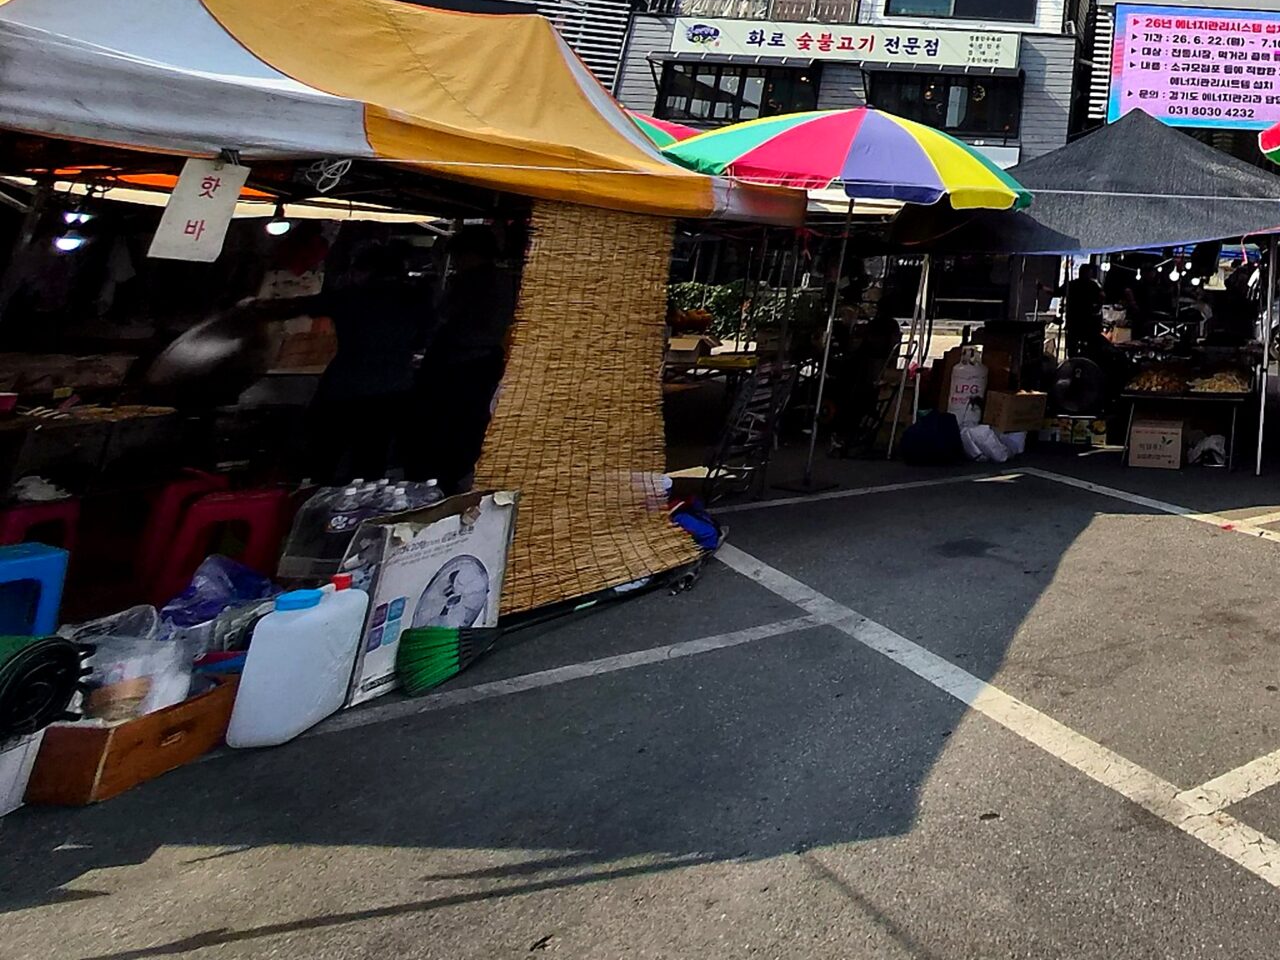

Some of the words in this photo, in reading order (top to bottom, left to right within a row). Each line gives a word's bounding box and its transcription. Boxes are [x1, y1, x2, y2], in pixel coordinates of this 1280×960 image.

[1145, 18, 1172, 29] 26년
[1175, 20, 1262, 34] 에너지관리시스템
[745, 29, 786, 49] 화로
[796, 31, 876, 54] 숯불고기
[884, 36, 939, 57] 전문점
[1143, 33, 1162, 43] 기간
[1142, 47, 1161, 57] 대상
[1218, 51, 1247, 61] 먹거리
[1141, 61, 1160, 71] 내용
[1171, 63, 1220, 74] 소규모점포
[1246, 66, 1276, 76] 적합한
[1253, 81, 1273, 90] 설치
[1139, 89, 1159, 99] 문의
[1169, 91, 1198, 101] 경기도
[1202, 93, 1262, 104] 에너지관리과
[1168, 106, 1188, 115] 031
[1191, 106, 1222, 117] 8030
[1225, 108, 1255, 118] 4232
[955, 385, 979, 395] LPG
